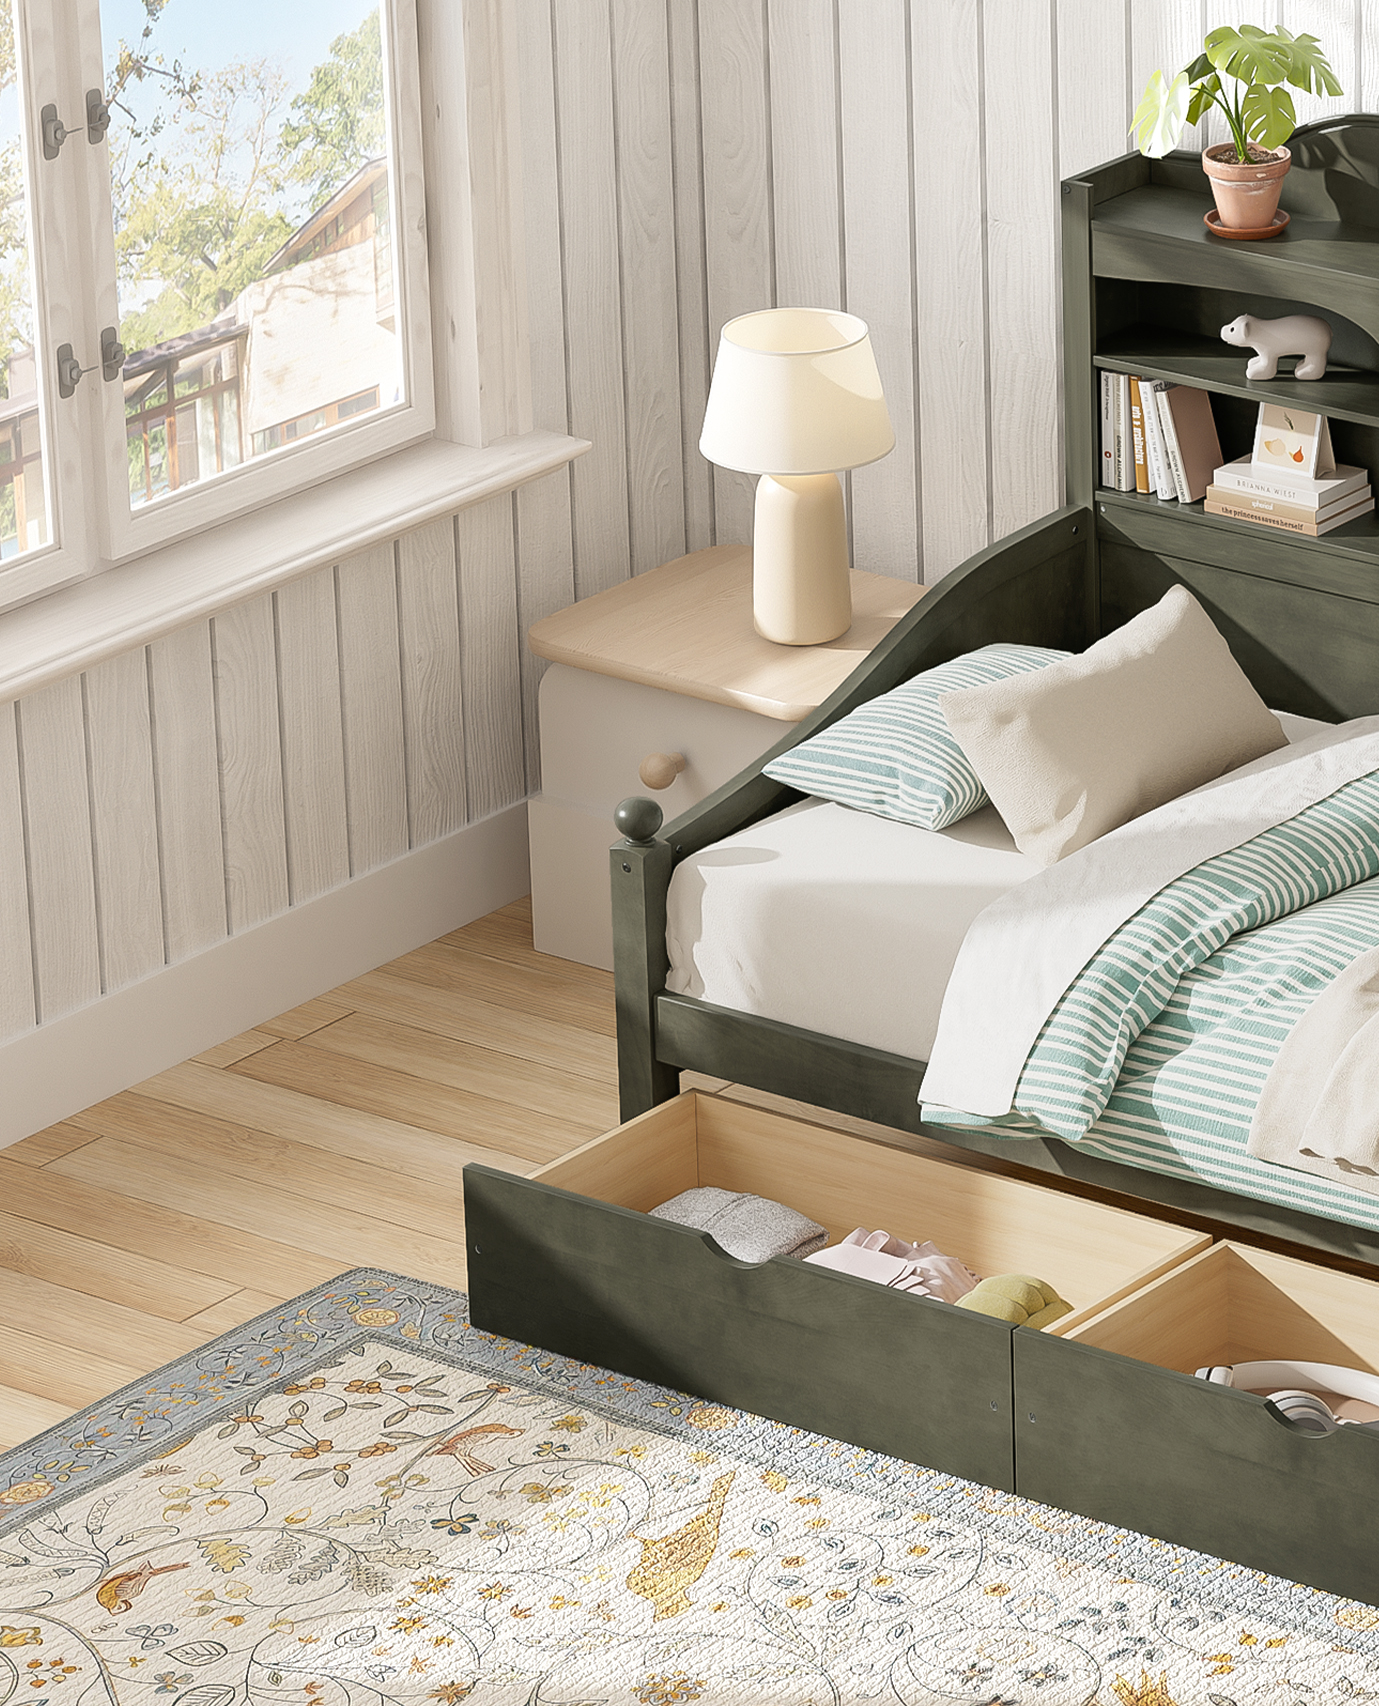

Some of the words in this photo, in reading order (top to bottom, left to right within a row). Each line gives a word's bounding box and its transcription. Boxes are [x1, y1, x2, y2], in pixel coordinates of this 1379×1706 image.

[1236, 479, 1271, 493] BRIANNA
[1274, 488, 1296, 500] WIEST
[1221, 507, 1233, 516] the
[1233, 510, 1262, 523] princess
[1261, 517, 1281, 526] saves
[1280, 519, 1304, 531] herself
